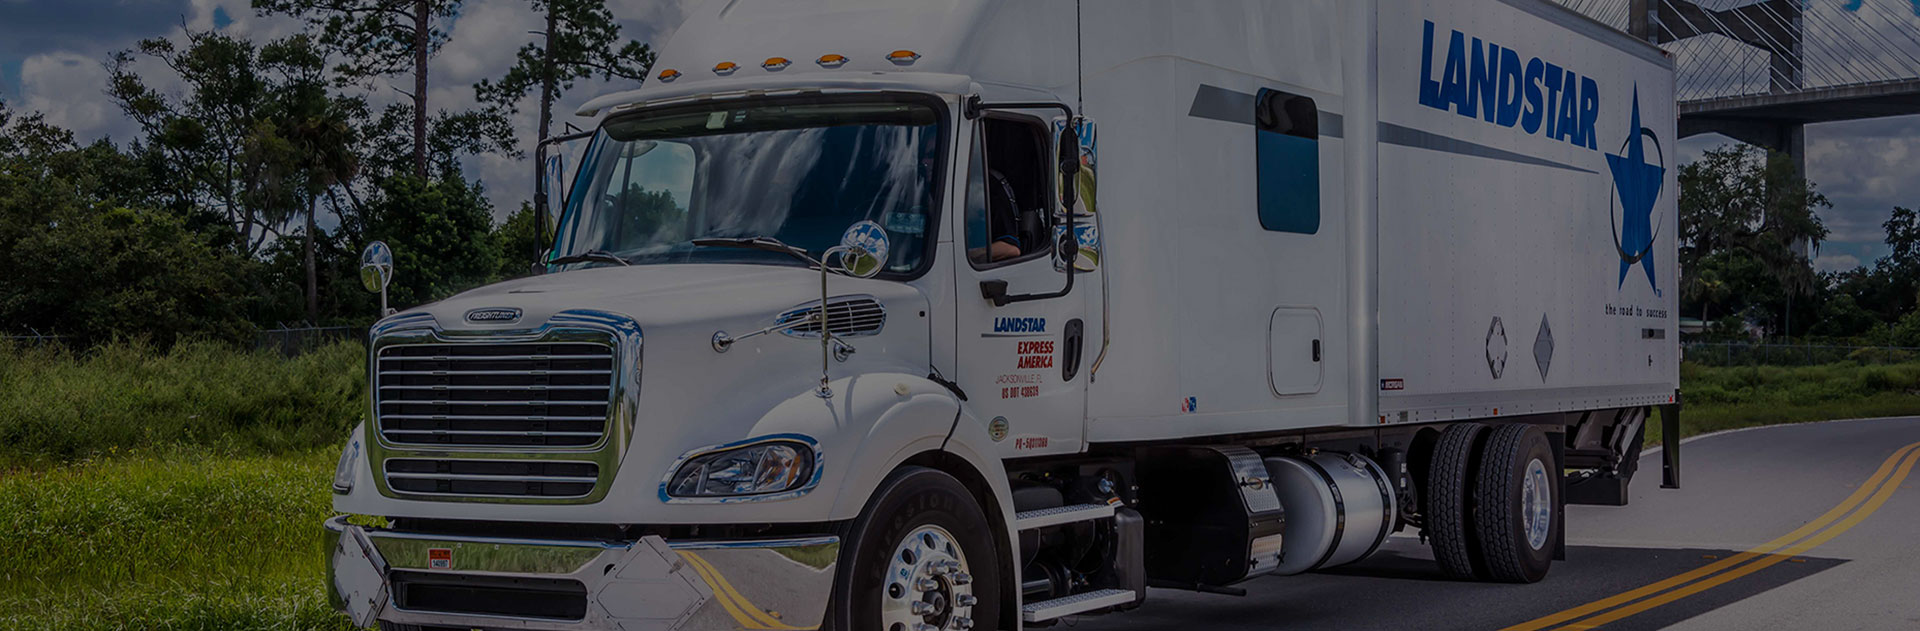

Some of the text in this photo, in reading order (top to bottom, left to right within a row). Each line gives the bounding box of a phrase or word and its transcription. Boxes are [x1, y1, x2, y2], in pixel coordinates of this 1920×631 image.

[1419, 19, 1599, 151] LANDSTAR
[1605, 303, 1667, 319] the road to success
[994, 317, 1046, 332] LANDSTAR
[1017, 341, 1054, 354] EXPRESS
[1017, 355, 1053, 369] AMERICA
[1002, 387, 1009, 399] US
[1010, 386, 1020, 398] DOT
